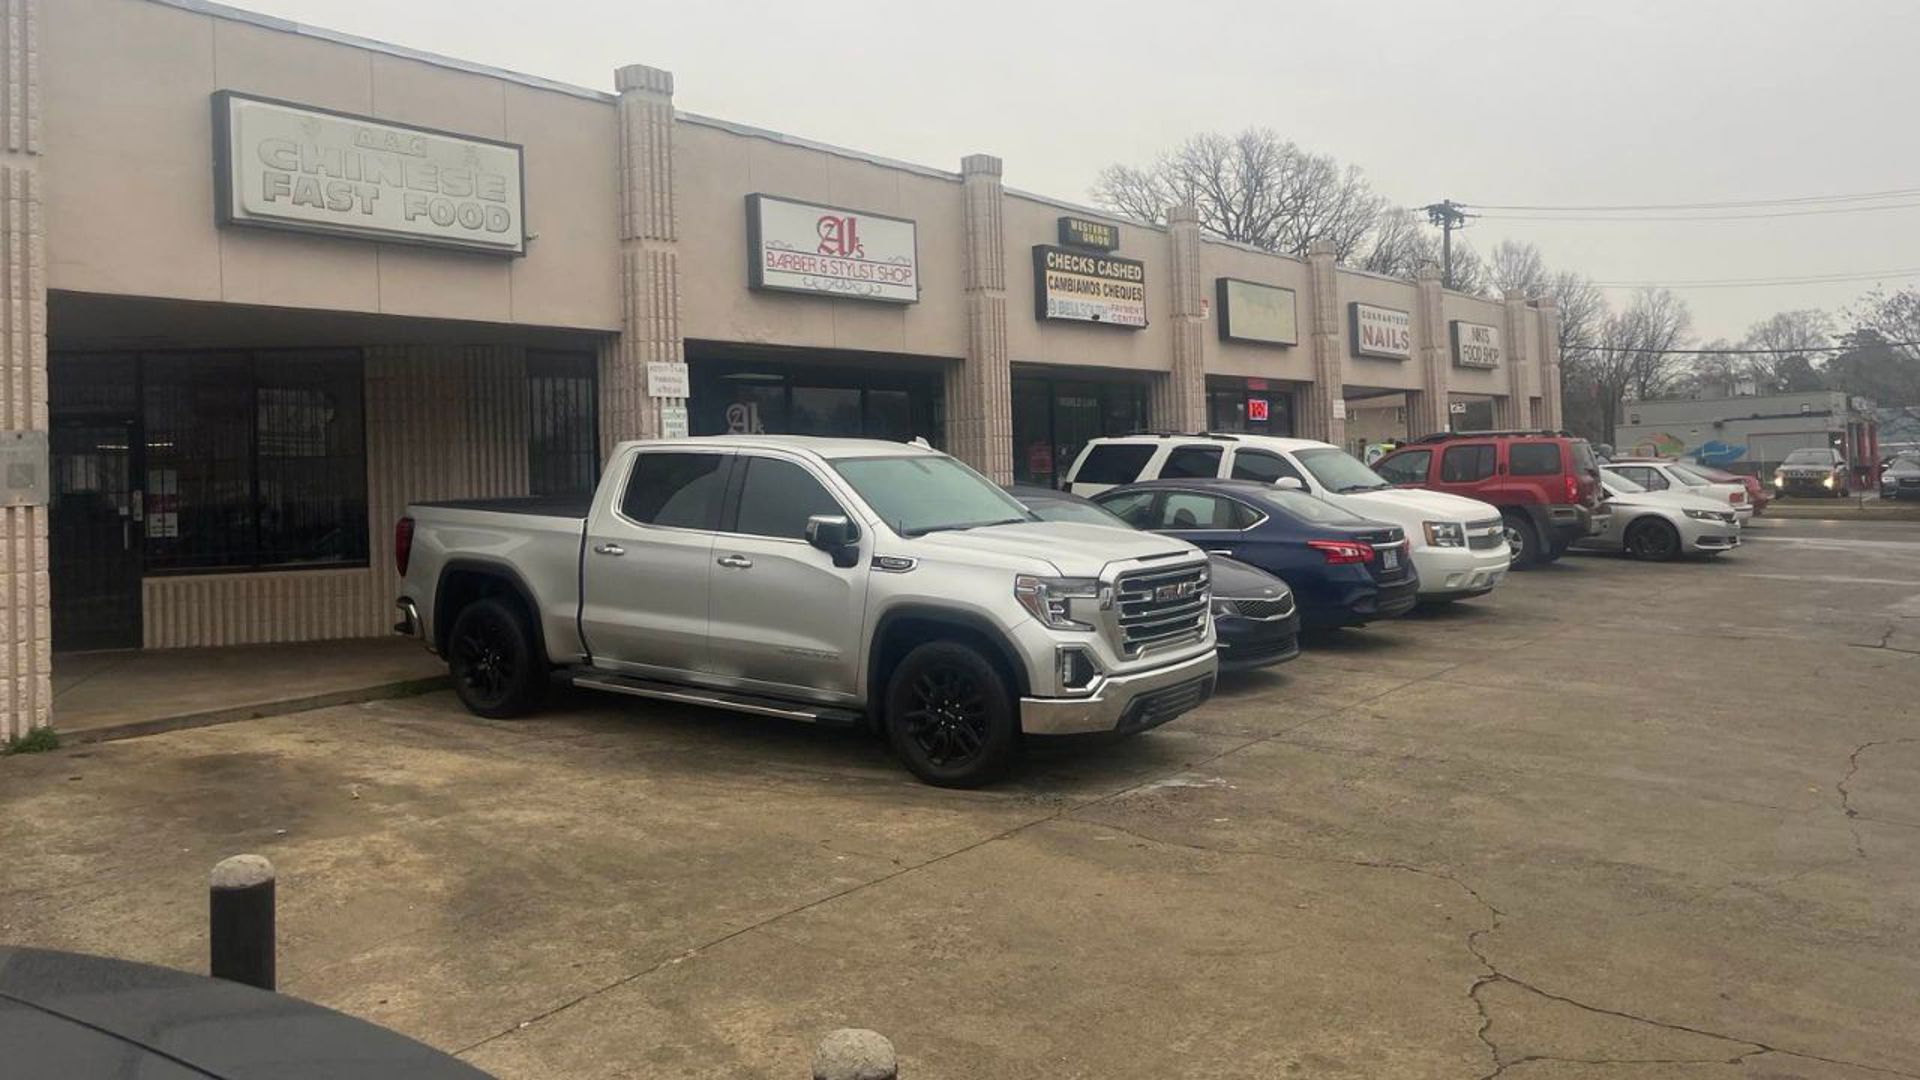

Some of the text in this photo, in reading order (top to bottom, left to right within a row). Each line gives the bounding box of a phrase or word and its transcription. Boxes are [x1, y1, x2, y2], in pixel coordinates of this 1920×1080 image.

[257, 137, 506, 202] CHINESE
[262, 171, 511, 233] FAST FOOD
[1070, 219, 1110, 235] WESTERN
[1083, 232, 1110, 246] UNION
[767, 251, 912, 282] BARBER & STYLIST SHOP
[1047, 252, 1142, 280] CHECKS CASHED
[1048, 275, 1142, 301] CAMBIAMOS CHEQUES
[1362, 324, 1409, 349] NAILS
